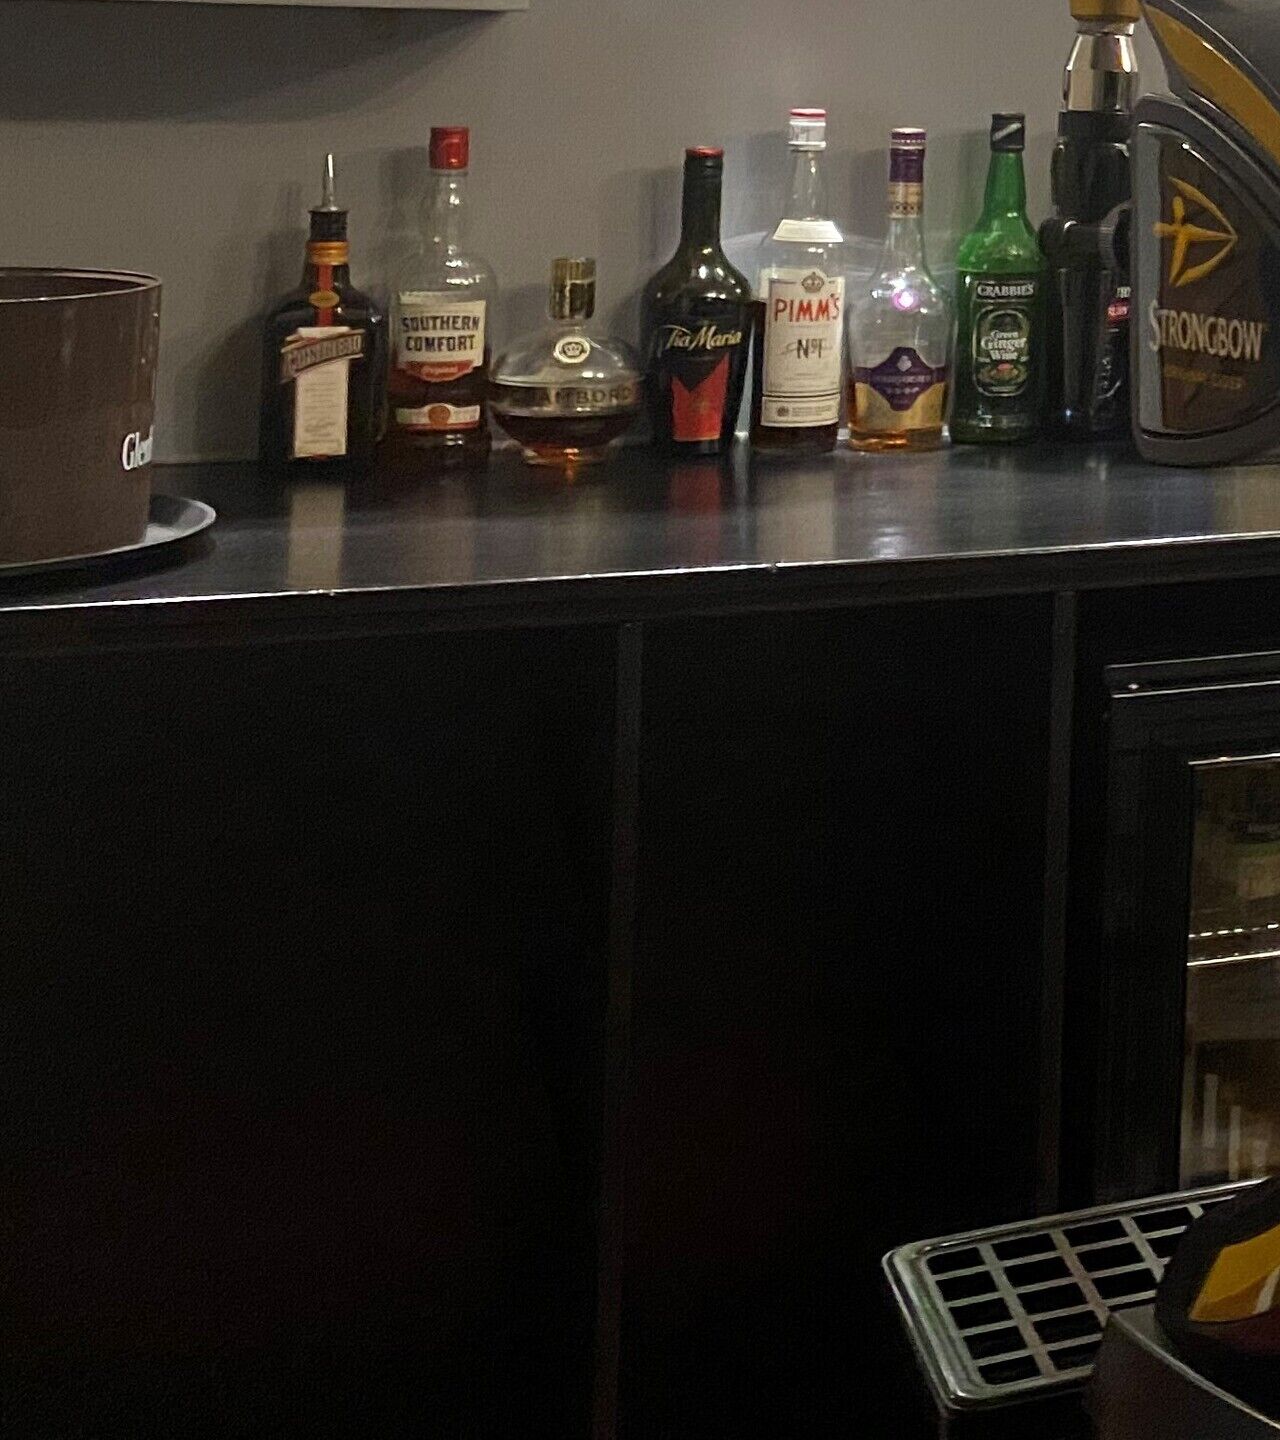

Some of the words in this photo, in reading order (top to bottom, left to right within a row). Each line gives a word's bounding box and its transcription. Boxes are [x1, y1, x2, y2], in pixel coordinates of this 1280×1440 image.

[977, 284, 1034, 297] CRABBIE'S
[774, 293, 840, 322] PIMM'S
[402, 315, 481, 335] SOUTHERN
[1148, 300, 1264, 361] STRONGBOW
[405, 334, 476, 353] COMFORT
[662, 324, 691, 350] Tia
[688, 324, 742, 351] Maria
[980, 337, 1027, 352] Ginger
